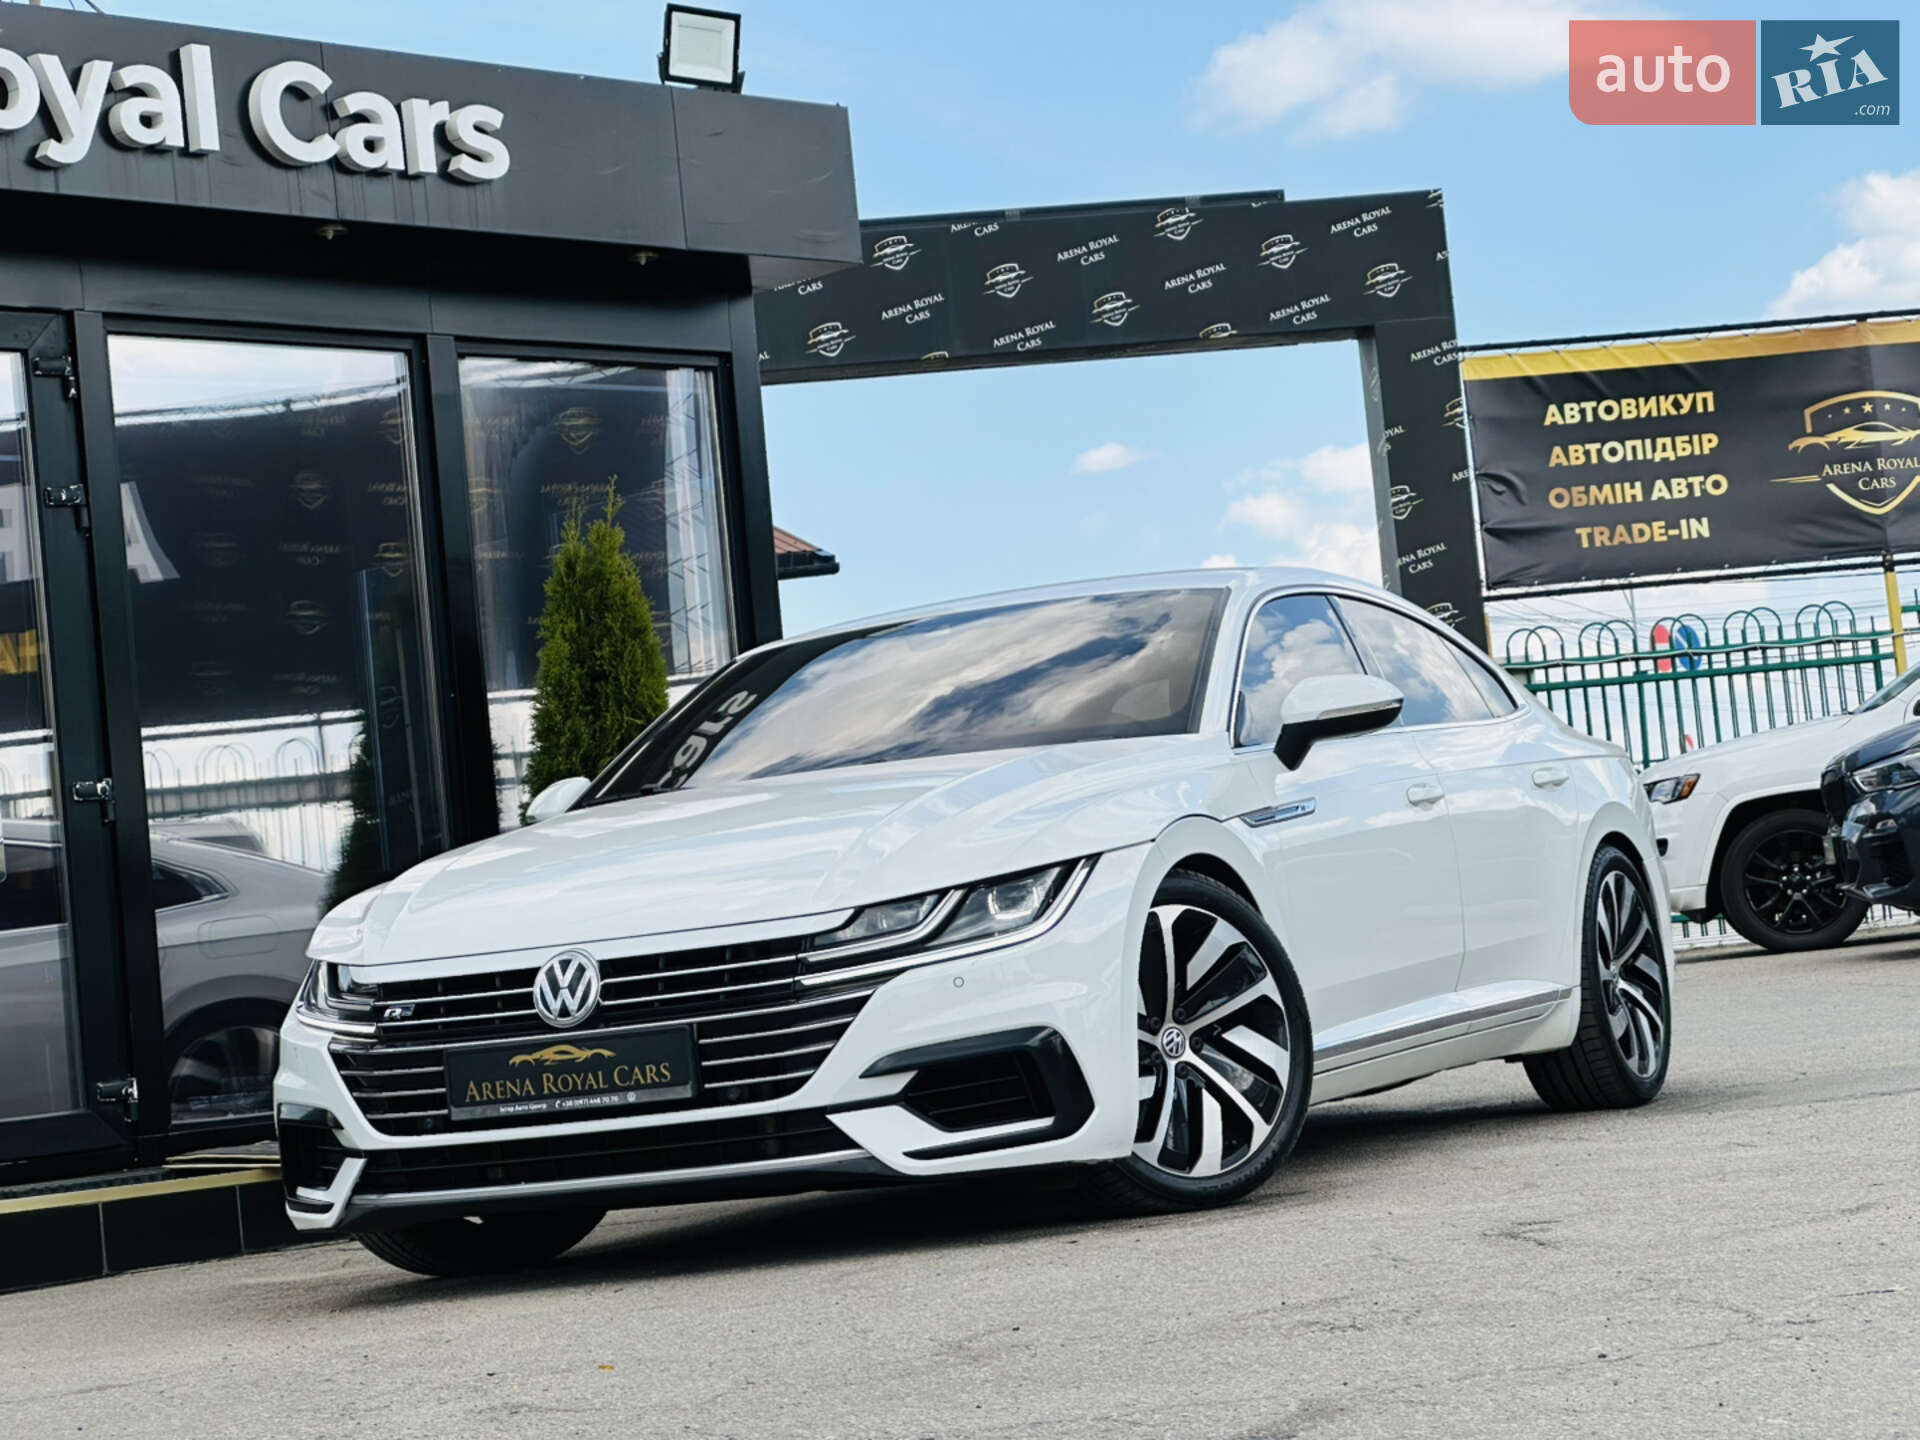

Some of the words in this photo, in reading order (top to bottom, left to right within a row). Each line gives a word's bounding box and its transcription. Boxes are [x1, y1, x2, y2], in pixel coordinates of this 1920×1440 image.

[248, 60, 511, 185] Cars
[974, 222, 1000, 237] CARS
[1330, 217, 1361, 234] ARENA
[1361, 205, 1393, 223] ROYAL
[1353, 222, 1378, 238] CARS
[1056, 245, 1088, 262] ARENA
[1088, 234, 1120, 252] ROYAL
[1080, 251, 1106, 266] CARS
[1164, 274, 1195, 291] ARENA
[1195, 262, 1227, 280] ROYAL
[1187, 278, 1213, 294] CARS
[798, 280, 824, 295] CARS
[881, 303, 913, 320] ARENA
[913, 293, 945, 310] ROYAL
[1269, 304, 1300, 321] ARENA
[1300, 293, 1332, 311] ROYAL
[905, 309, 931, 325] CARS
[1292, 310, 1317, 326] CARS
[993, 330, 1025, 348] ARENA
[1025, 320, 1057, 337] ROYAL
[1016, 336, 1042, 352] CARS
[1410, 346, 1441, 362] ARENA
[1543, 390, 1717, 427] АВТОВИКУП
[1548, 433, 1720, 468] АВТОПІДБІР
[1822, 461, 1873, 477] ARENA
[1876, 457, 1920, 470] ROYAL
[1548, 482, 1644, 509] ОБМІН
[1651, 473, 1729, 501] АВТО
[1858, 476, 1897, 490] CARS
[1576, 517, 1711, 549] TRADE-IN
[1416, 542, 1448, 559] ROYAL
[1408, 559, 1434, 574] CARS
[465, 1080, 536, 1102] ARENA
[542, 1071, 608, 1095] ROYAL
[613, 1063, 671, 1087] CARS
